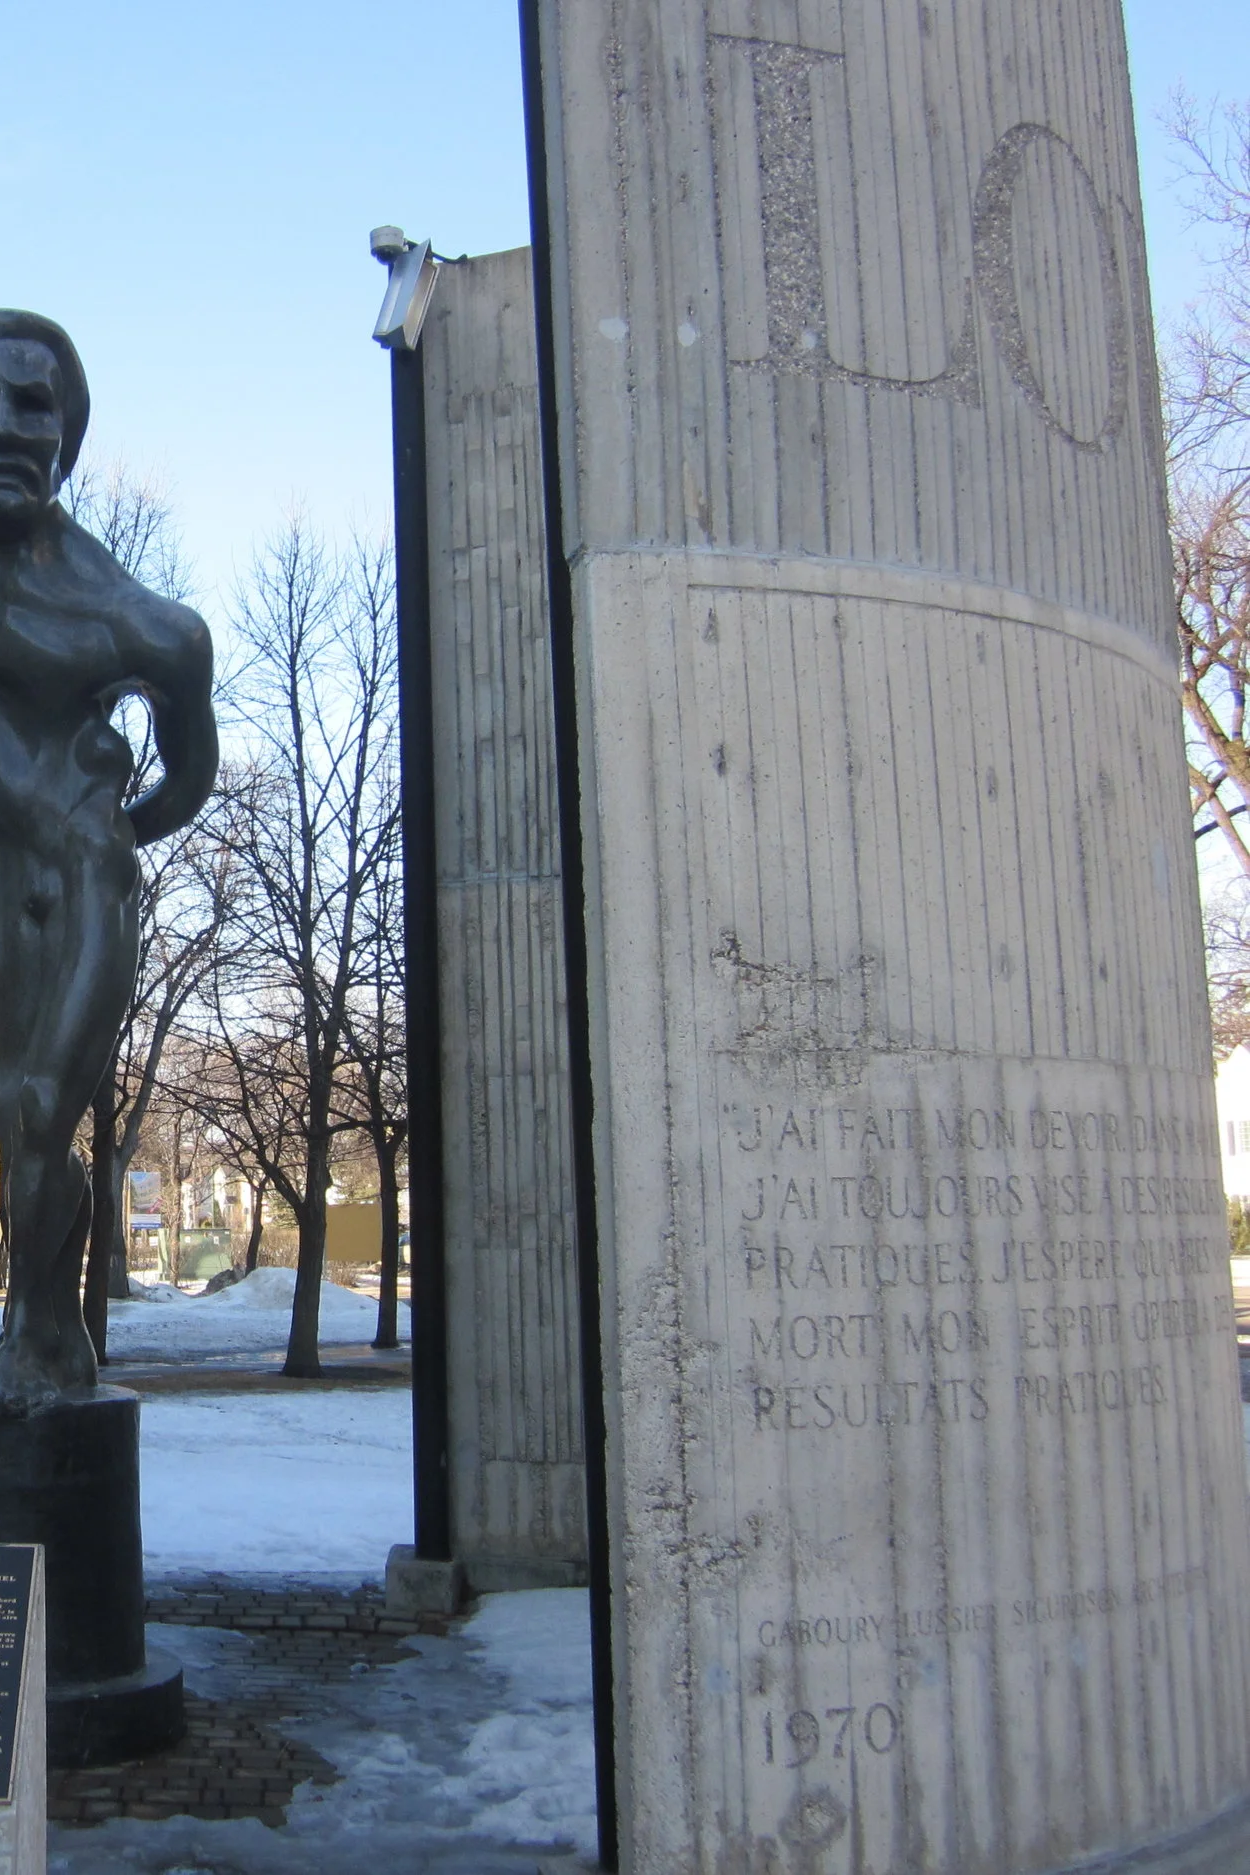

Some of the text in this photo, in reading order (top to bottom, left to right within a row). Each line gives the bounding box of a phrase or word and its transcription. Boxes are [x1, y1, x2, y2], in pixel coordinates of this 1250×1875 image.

[708, 34, 1162, 455] LO
[837, 1107, 922, 1150] FAIT
[935, 1108, 1017, 1150] MON
[741, 1174, 818, 1221] J'AI
[831, 1174, 1023, 1221] TOUJOURS
[745, 1243, 984, 1290] PRATIQUES.
[901, 1310, 990, 1355] MON
[1020, 1303, 1120, 1349] ESPRIT
[758, 1614, 885, 1648] GABOURY
[764, 1702, 898, 1769] 1970
